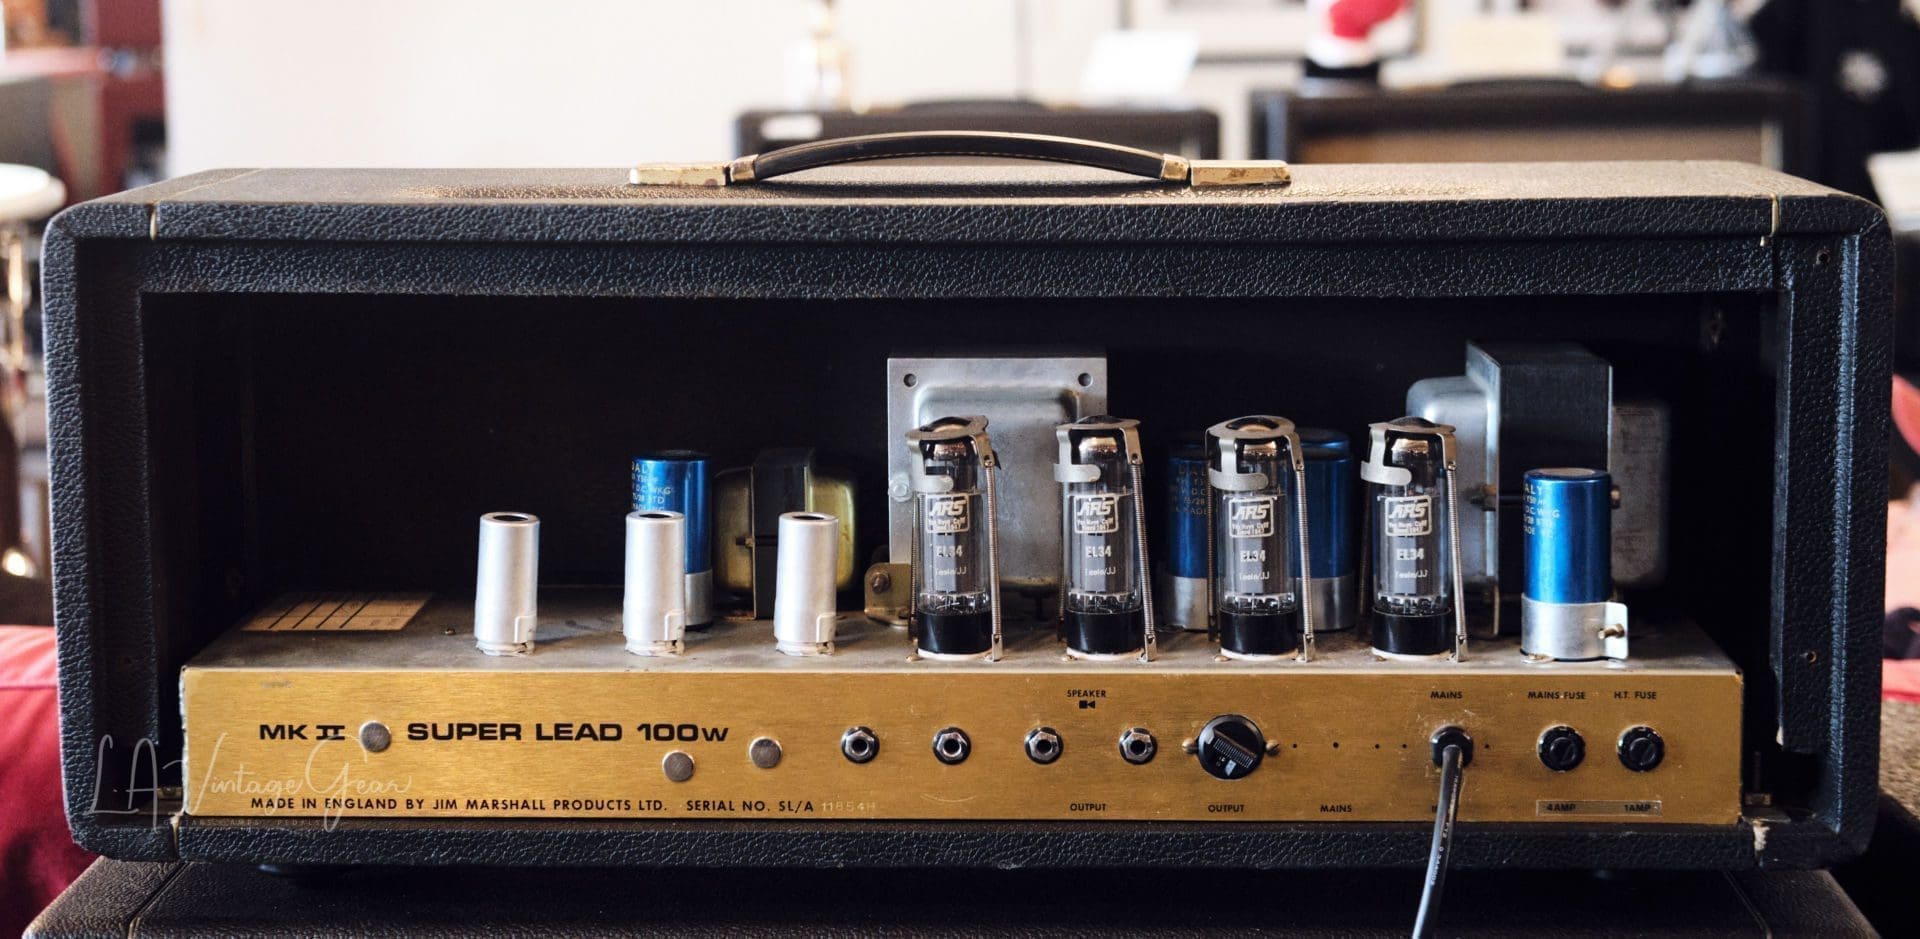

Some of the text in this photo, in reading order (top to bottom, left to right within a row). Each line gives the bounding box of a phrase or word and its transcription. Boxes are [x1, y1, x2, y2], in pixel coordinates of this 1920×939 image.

[1085, 545, 1112, 558] EL34
[1067, 689, 1106, 698] SPEAKER
[1430, 691, 1463, 699] MAINS
[1528, 691, 1586, 700] MAINS FUSE
[1634, 691, 1657, 700] FUSE
[259, 724, 307, 740] MK
[407, 722, 522, 741] SUPER
[535, 722, 623, 742] LEAD
[251, 798, 294, 810] MADE
[302, 798, 317, 810] IN
[324, 798, 397, 810] ENGLAND
[406, 798, 424, 810] BY
[433, 798, 458, 810] JIM
[466, 798, 546, 810] MARSHALL
[553, 798, 631, 810] PRODUCTS
[638, 798, 667, 810] LTD.
[686, 798, 735, 810] SERIAL
[742, 798, 771, 810] NO.
[778, 799, 814, 814] SL/A
[1069, 803, 1107, 812] OUTPUT
[1207, 804, 1245, 813] OUTPUT
[1320, 804, 1353, 813] MAINS
